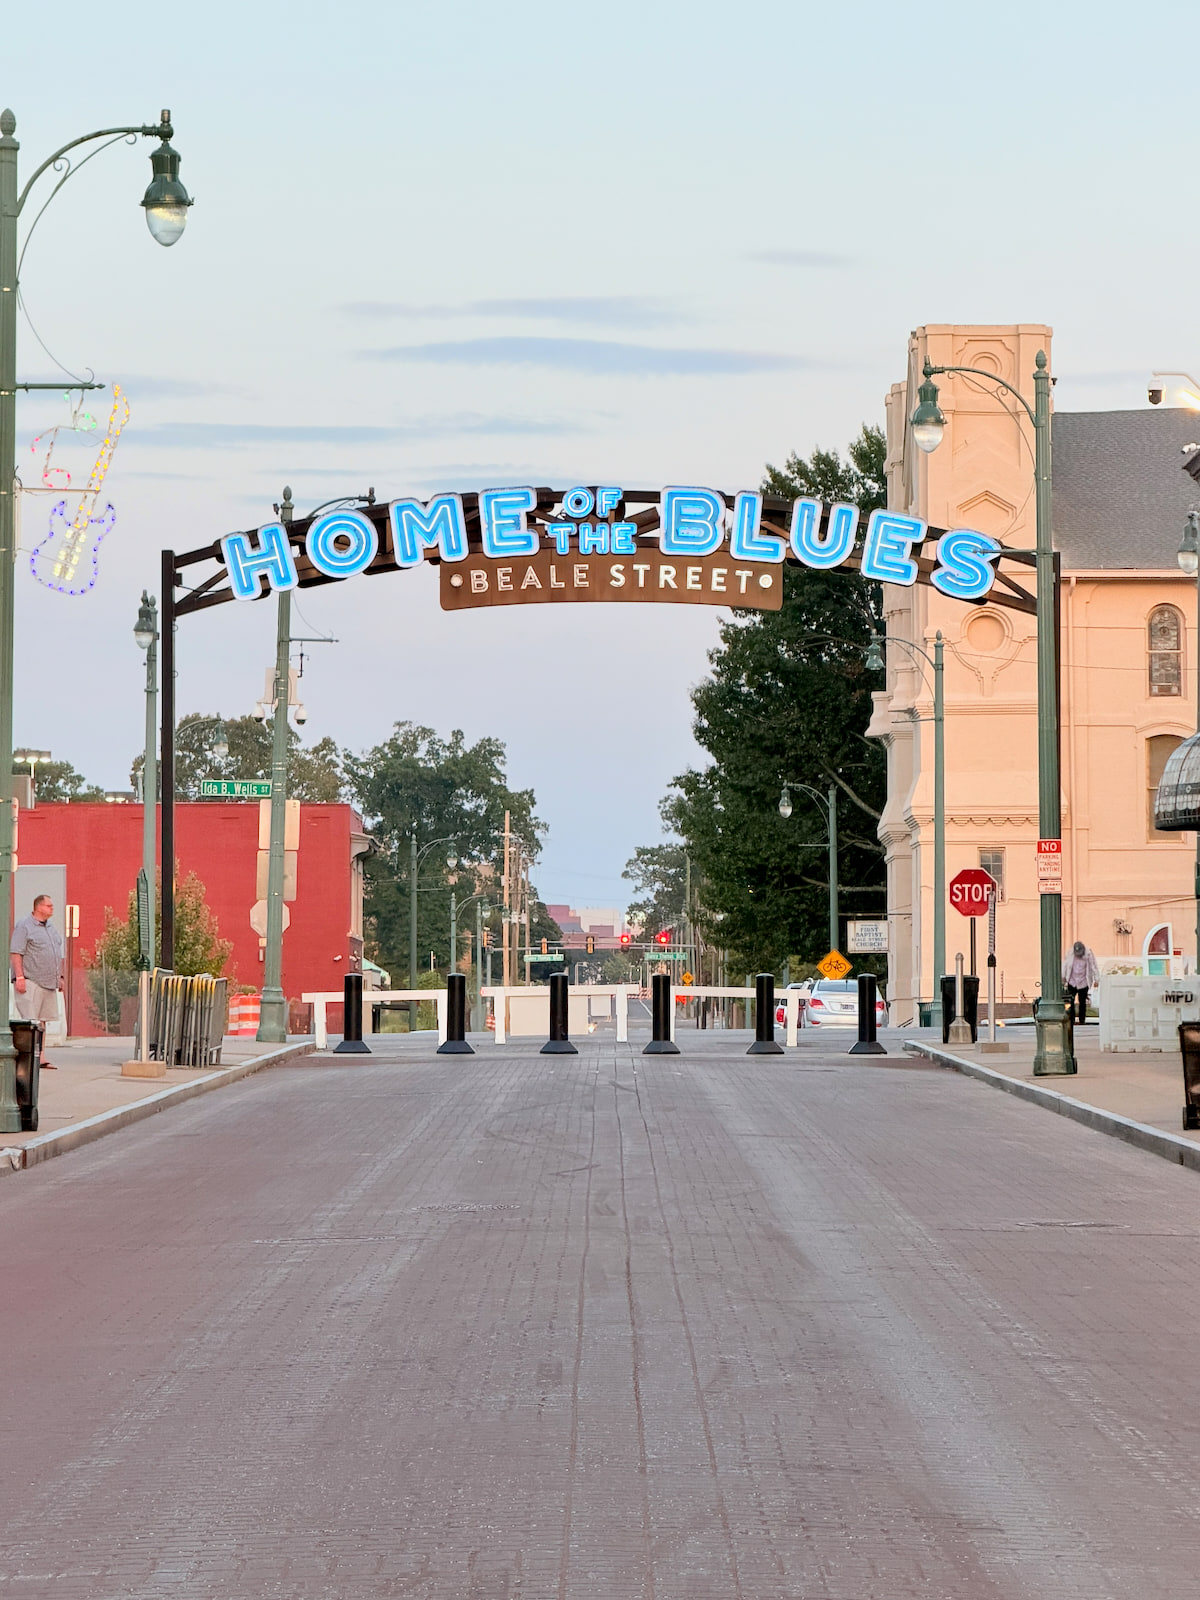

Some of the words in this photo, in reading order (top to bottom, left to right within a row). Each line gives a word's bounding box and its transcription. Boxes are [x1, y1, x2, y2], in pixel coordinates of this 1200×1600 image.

[562, 486, 623, 518] OF
[220, 486, 540, 601] HOME
[547, 522, 638, 555] THE
[659, 485, 1002, 600] BLUES
[470, 564, 589, 595] BEALE
[610, 564, 753, 594] STREET
[204, 783, 218, 794] Ida
[221, 783, 230, 794] B.
[234, 783, 258, 795] Wells
[1041, 842, 1057, 852] NO
[952, 883, 992, 903] STOP
[1165, 990, 1193, 1003] MPD
